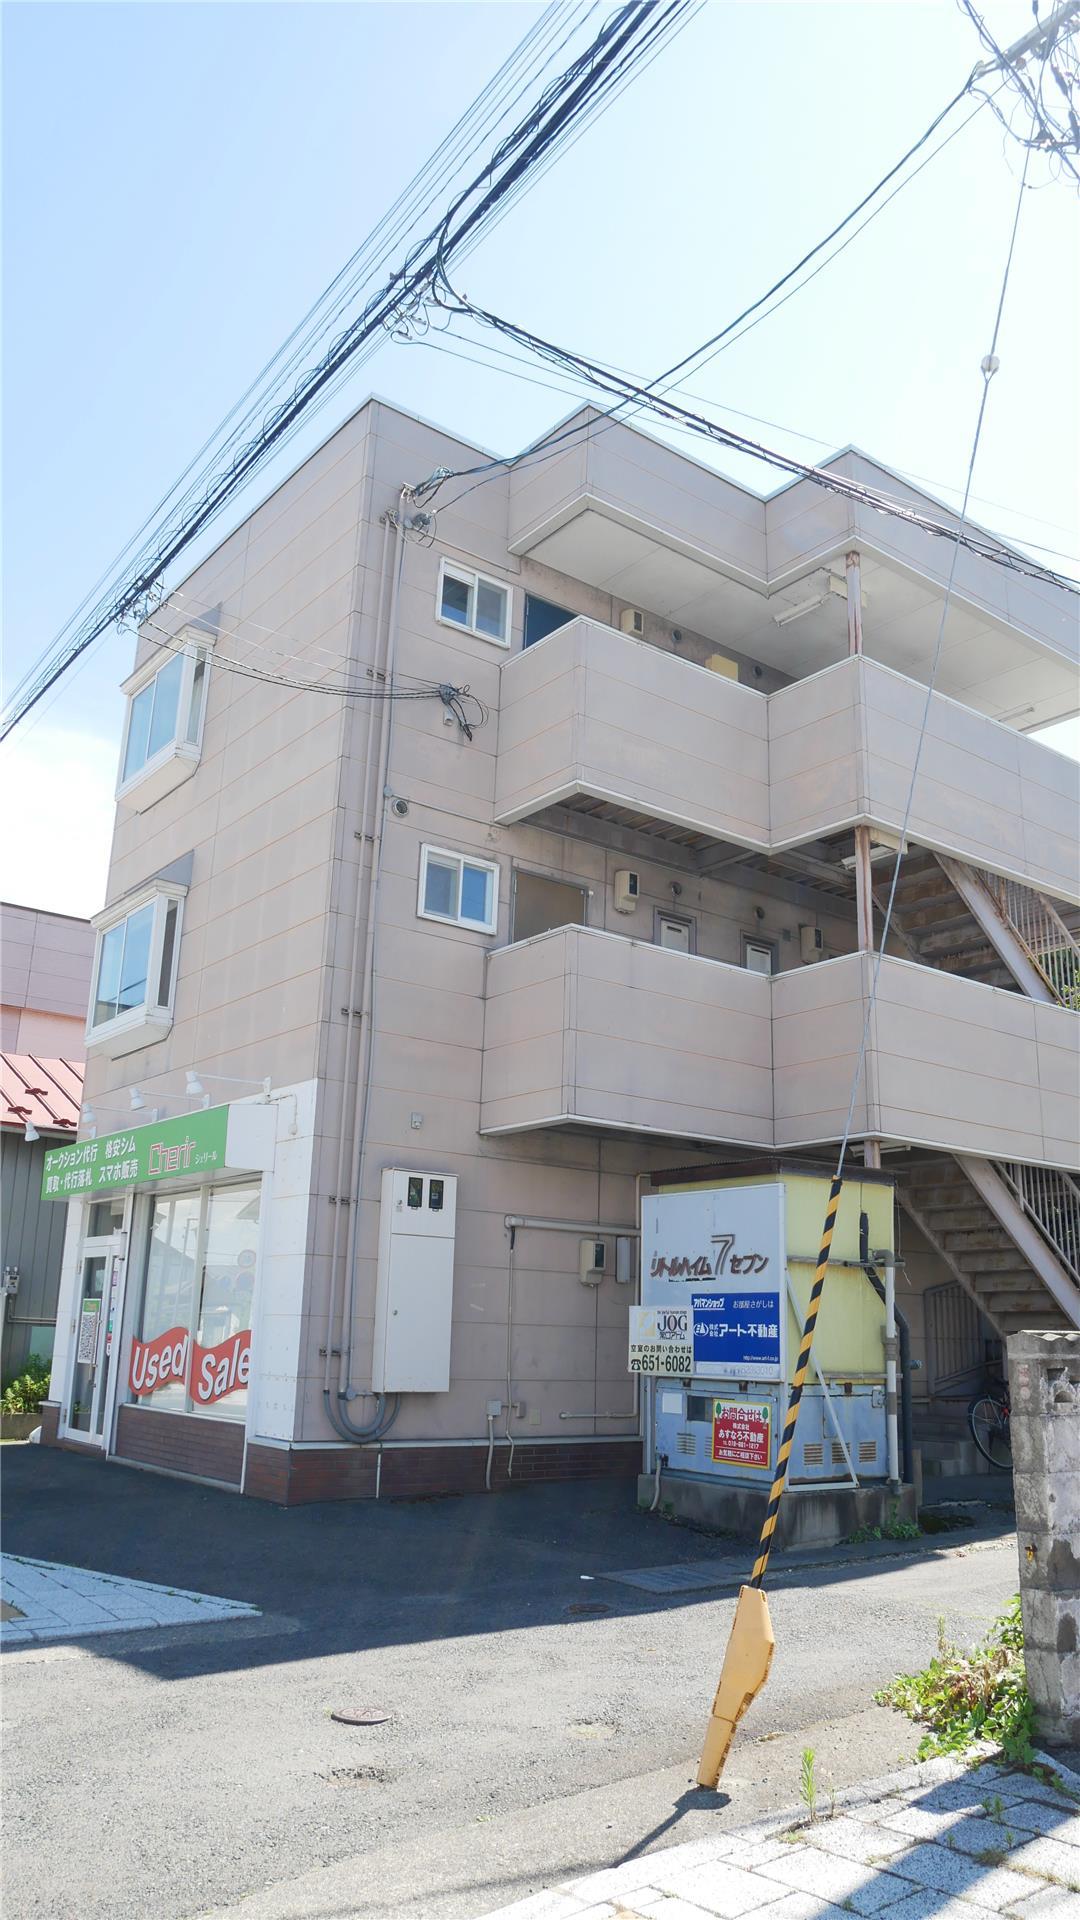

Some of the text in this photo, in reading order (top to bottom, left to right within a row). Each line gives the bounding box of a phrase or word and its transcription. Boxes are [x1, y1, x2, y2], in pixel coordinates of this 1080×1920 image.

[45, 1135, 136, 1172] オークション代行 格安シム
[194, 1150, 218, 1165] シェリール
[45, 1159, 139, 1194] 買取・代行落札 スマホ販売
[730, 1253, 770, 1275] セブン
[693, 1297, 774, 1309] アパマンショップ お部屋さがしは
[657, 1314, 688, 1331] JOG
[719, 1323, 778, 1338] アート不動産
[630, 1344, 692, 1354] 空室のお問い合わせは
[132, 1334, 189, 1390] Used
[198, 1338, 251, 1401] Sale
[641, 1354, 691, 1373] 651-6082
[718, 1429, 764, 1444] あすなろ不動産
